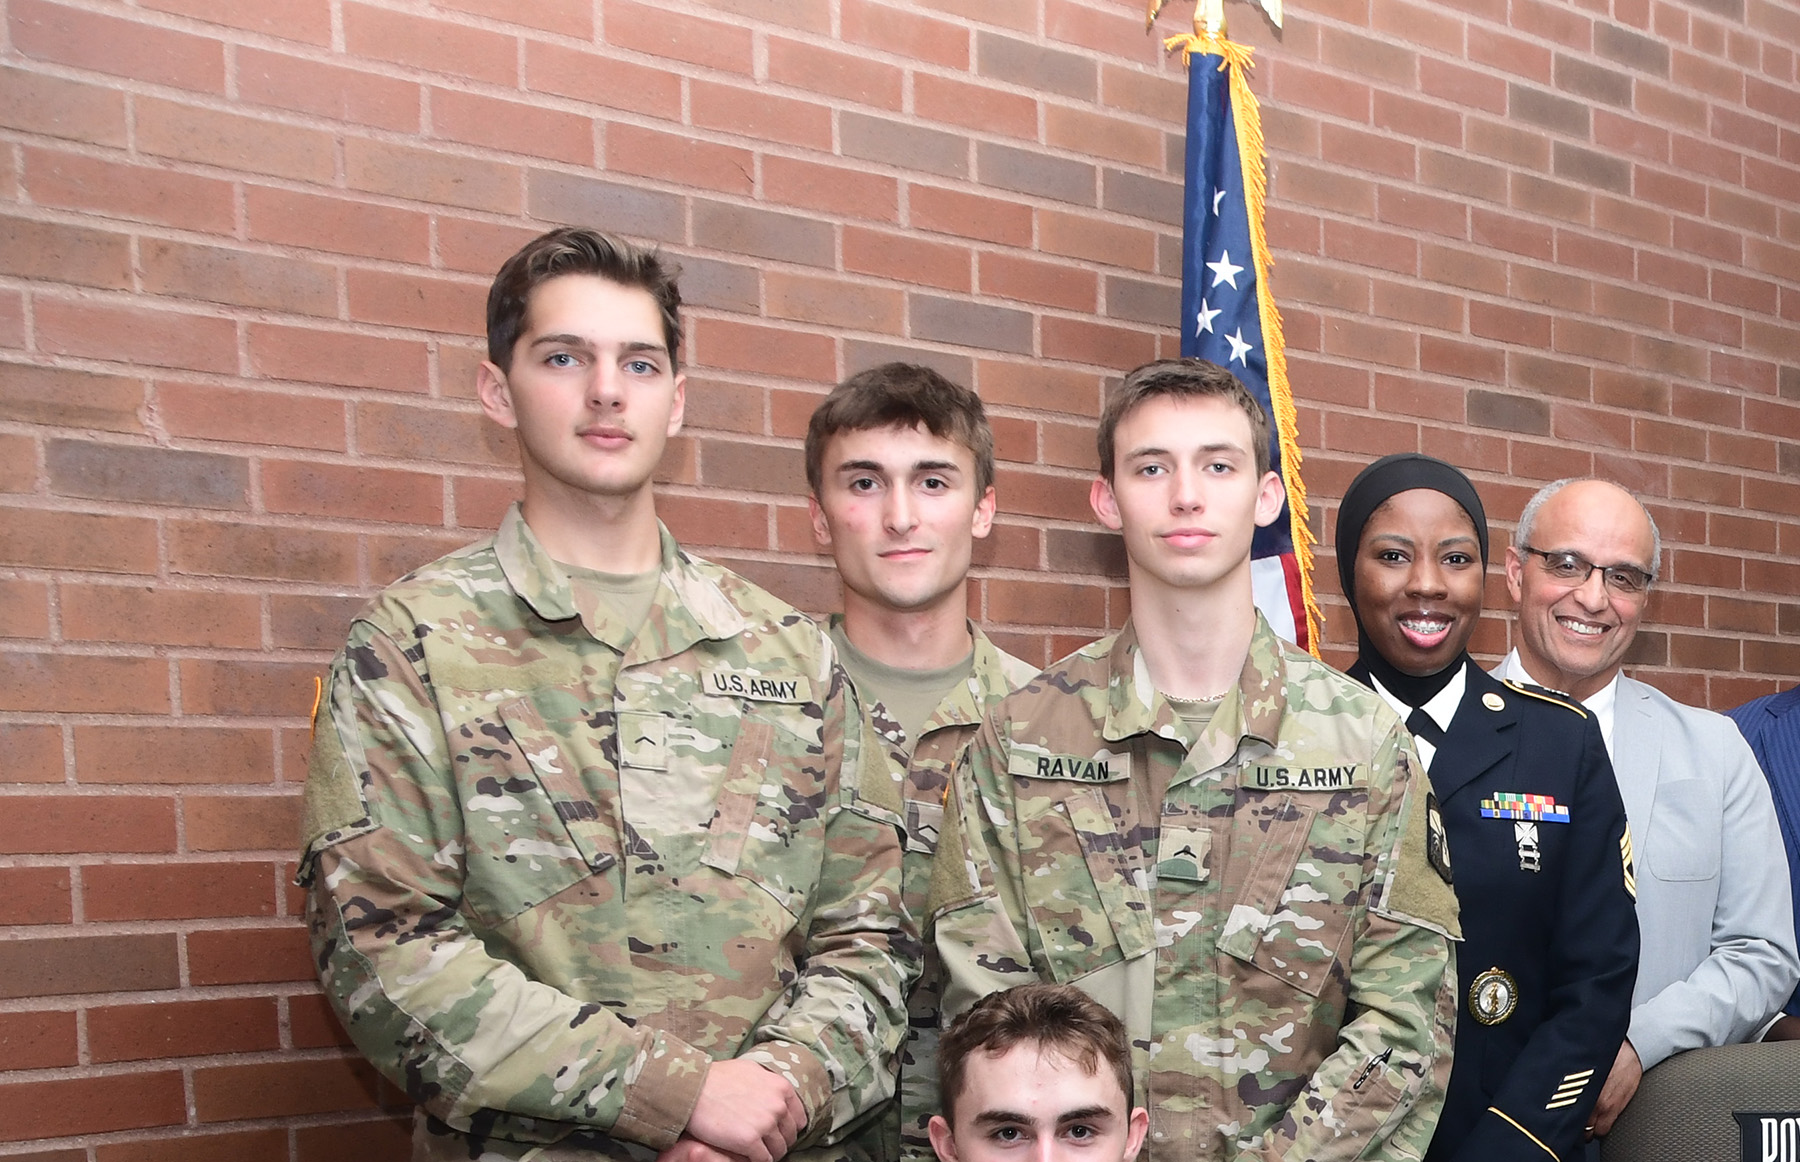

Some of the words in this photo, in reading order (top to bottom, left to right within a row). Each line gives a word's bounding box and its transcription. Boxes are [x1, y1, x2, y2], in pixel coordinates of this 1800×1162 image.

[713, 673, 748, 694] U.S.
[750, 679, 797, 699] ARMY
[1036, 756, 1109, 780] RAVAN
[1256, 766, 1296, 787] U.S.
[1298, 766, 1356, 787] ARMY
